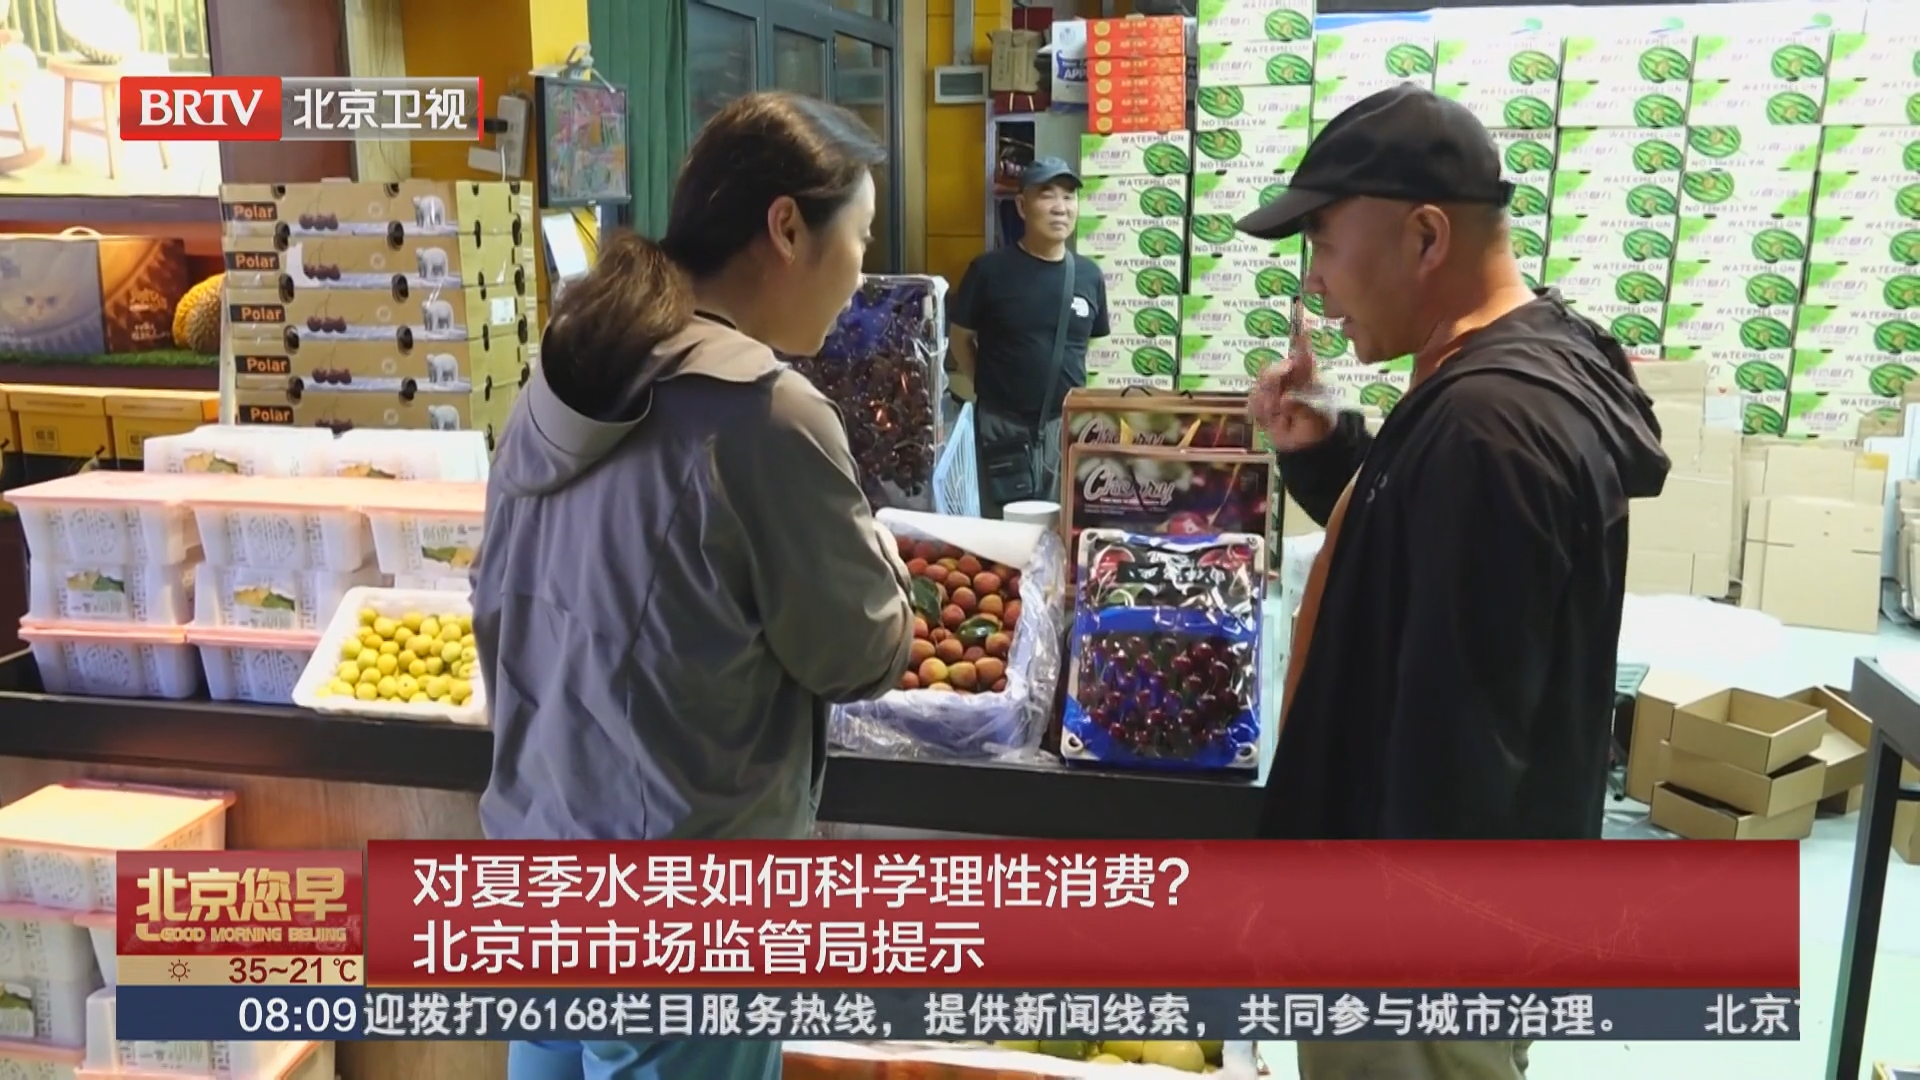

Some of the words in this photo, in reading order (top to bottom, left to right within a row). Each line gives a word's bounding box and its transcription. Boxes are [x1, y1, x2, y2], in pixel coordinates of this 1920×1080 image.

[1121, 134, 1185, 144] WATERMELON
[1492, 130, 1552, 140] ATERMELON
[1118, 178, 1181, 188] WATERMELON
[233, 204, 274, 220] Polar
[1117, 217, 1180, 228] WATERMELON
[235, 254, 276, 270] Polar
[1115, 258, 1177, 268] WATERMELON
[1233, 258, 1297, 268] WATERMELON
[1593, 262, 1663, 271] WATERMELON
[1722, 264, 1796, 274] WATERMELON
[1112, 298, 1175, 308] WATERMELON
[1223, 298, 1286, 308] WATERMELON
[241, 305, 282, 321] Polar
[1588, 303, 1658, 314] WATERMELON
[1717, 307, 1790, 317] WATERMELON
[1110, 338, 1173, 348] WATERMELON
[1222, 338, 1286, 349] WATERMELON
[1712, 351, 1785, 361] WATERMELON
[246, 356, 287, 373] Polar
[1108, 376, 1169, 387] WATERMELON
[1337, 373, 1405, 384] WATERMELON
[250, 406, 291, 423] Polar
